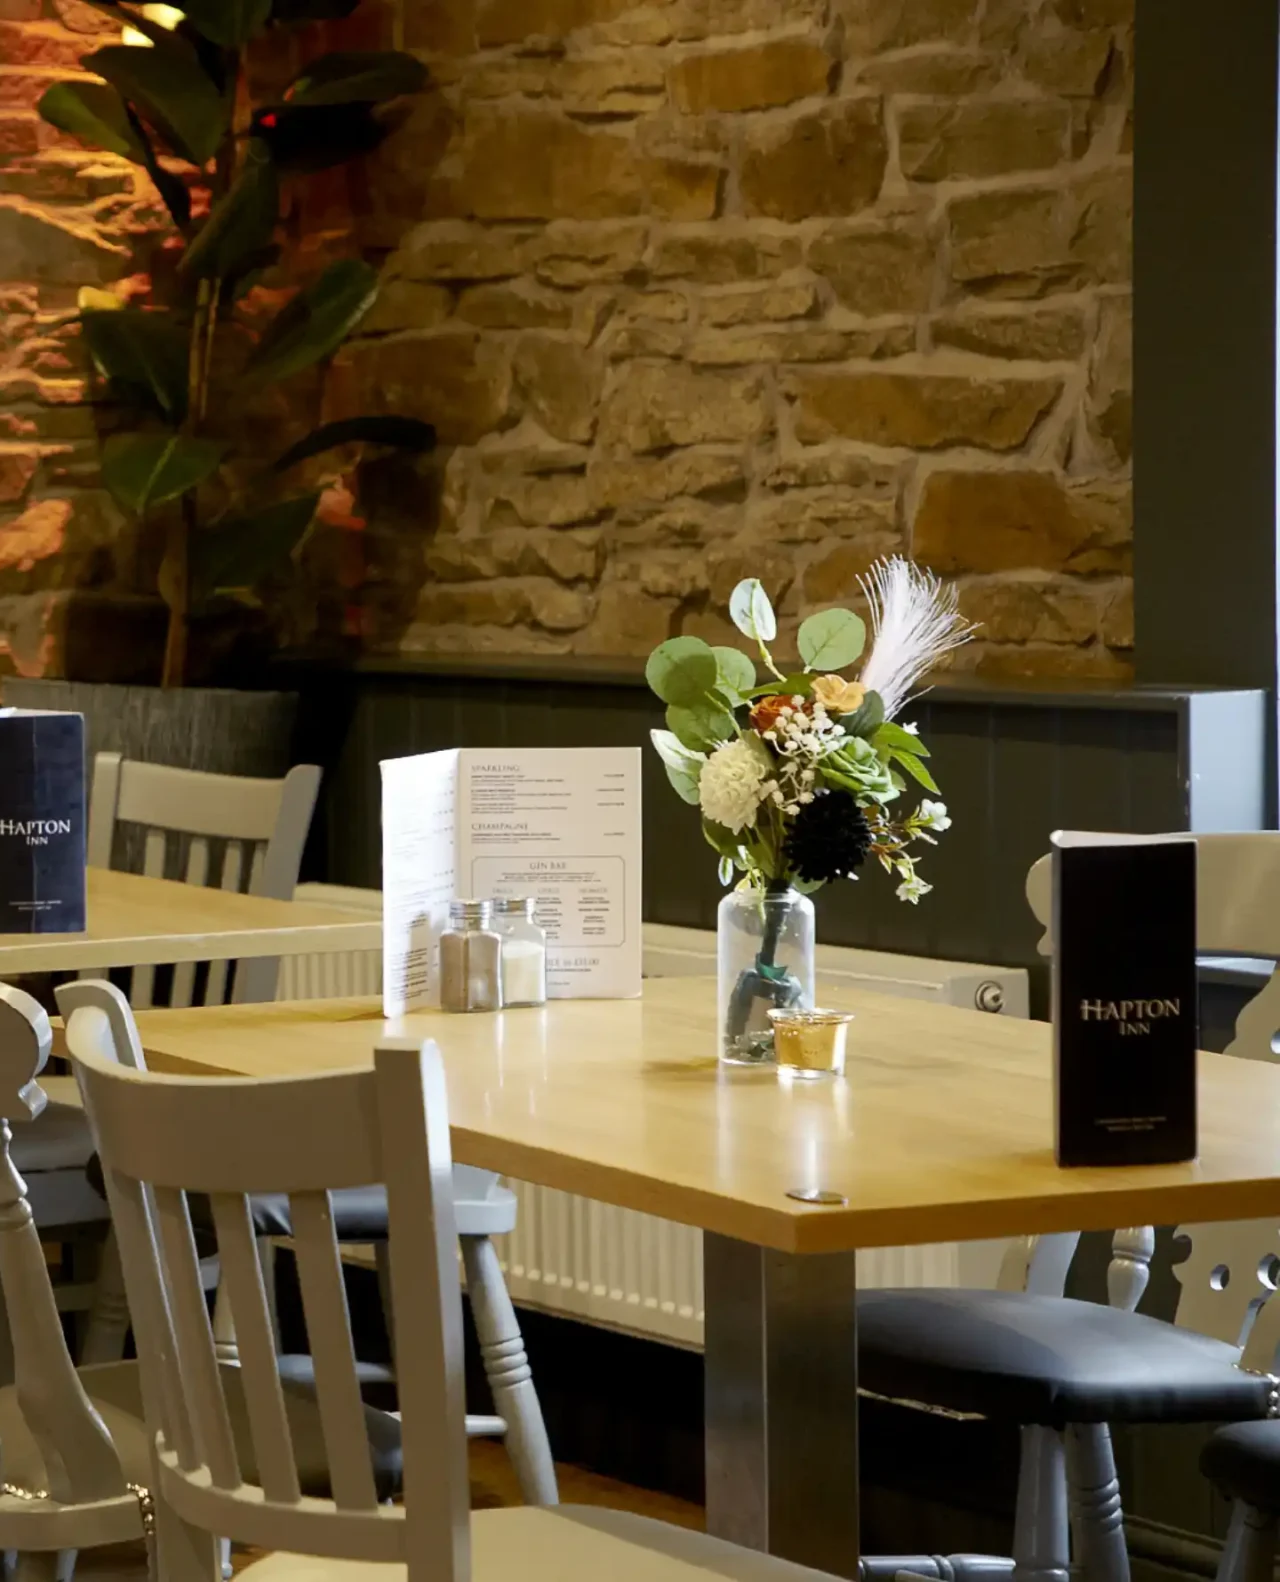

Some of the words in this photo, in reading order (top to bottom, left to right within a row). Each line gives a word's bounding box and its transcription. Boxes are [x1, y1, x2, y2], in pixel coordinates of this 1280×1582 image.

[26, 836, 49, 846] INN
[1080, 998, 1181, 1021] HAPTON
[1119, 1021, 1151, 1036] INN
